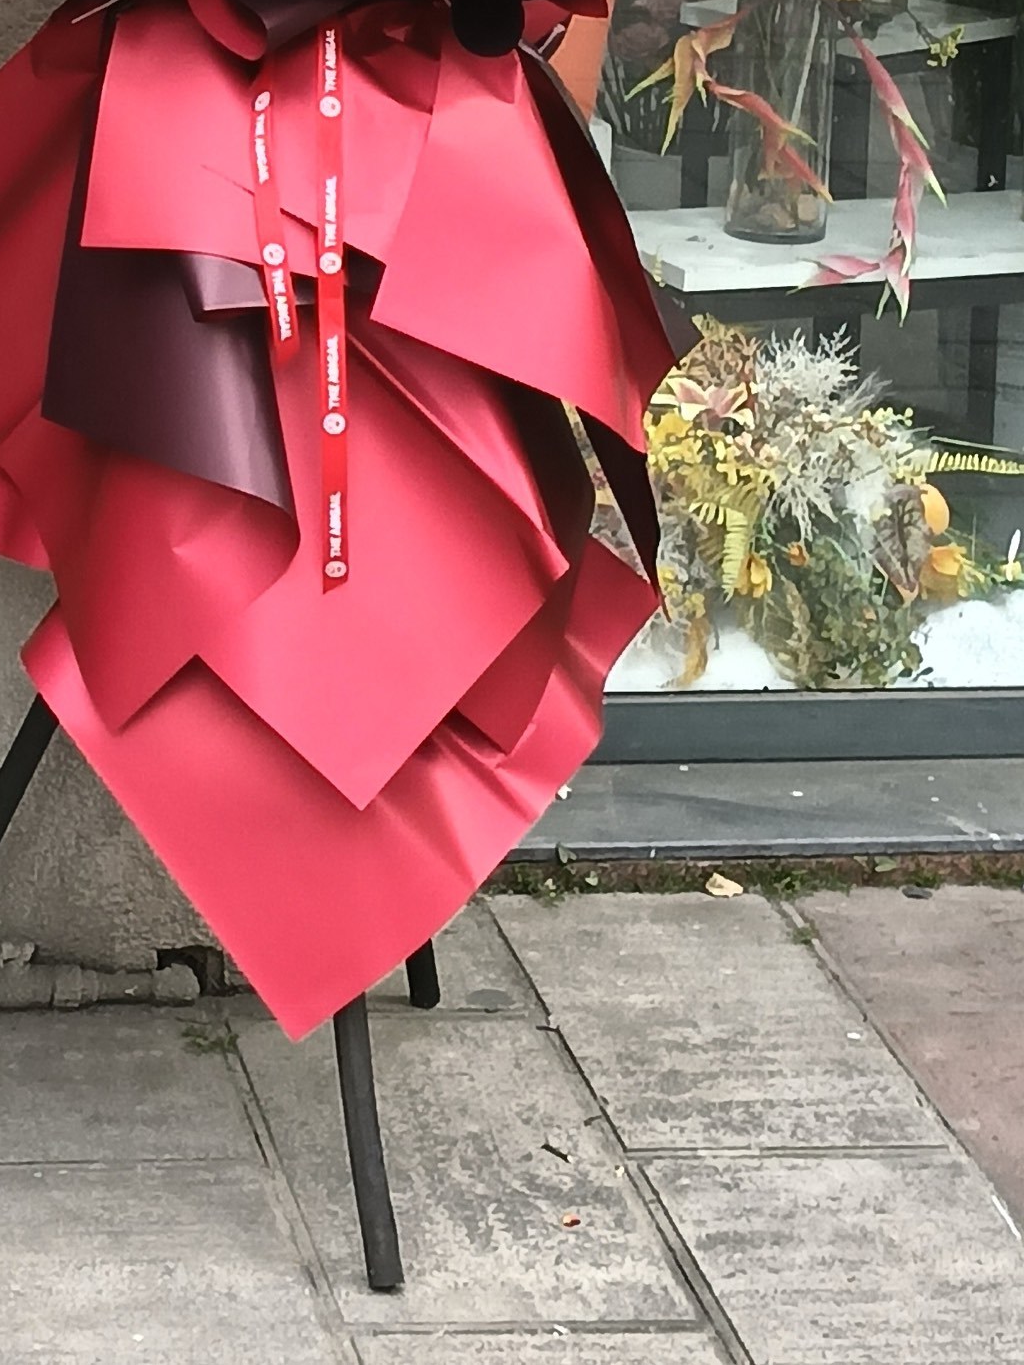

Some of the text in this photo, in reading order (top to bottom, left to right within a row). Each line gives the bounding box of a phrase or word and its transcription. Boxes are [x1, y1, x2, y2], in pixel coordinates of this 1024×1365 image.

[324, 222, 337, 247] THE
[271, 268, 286, 295] THE
[327, 384, 340, 409] THE
[330, 536, 342, 558] THE
